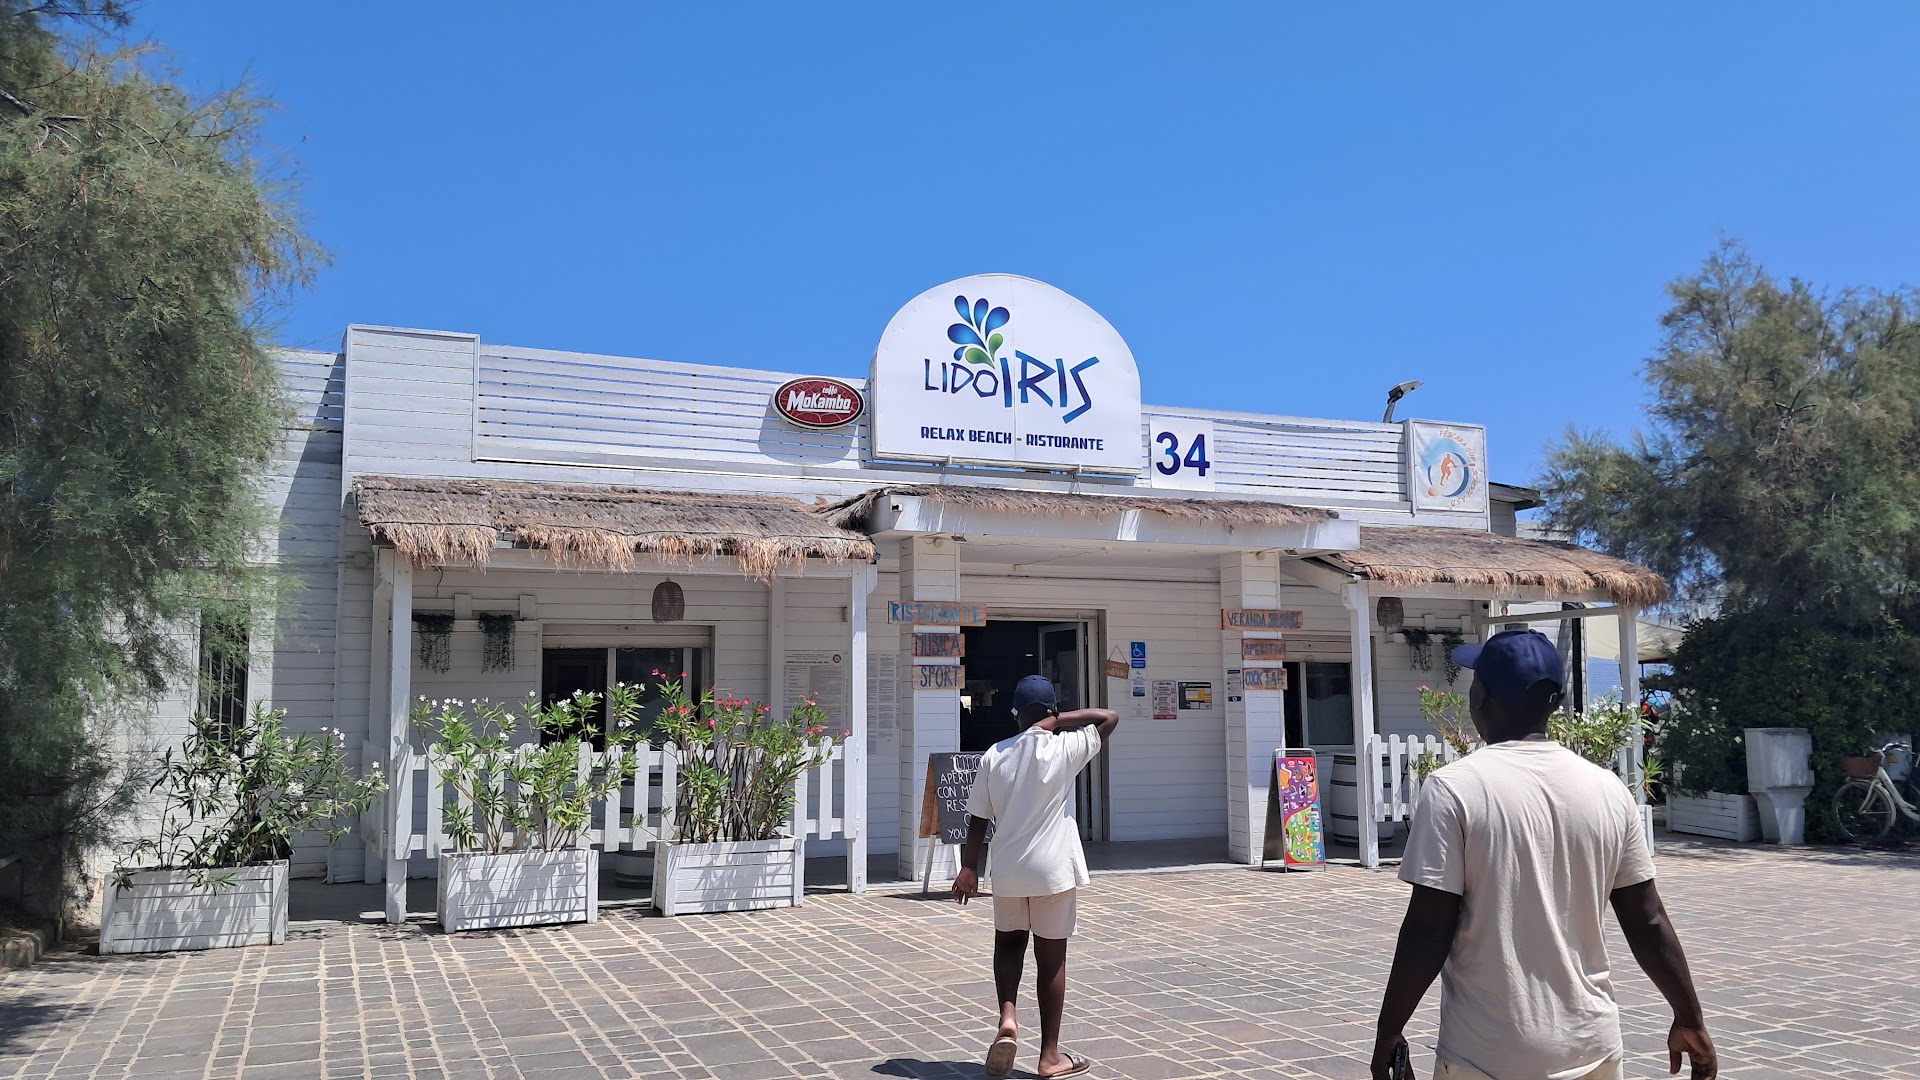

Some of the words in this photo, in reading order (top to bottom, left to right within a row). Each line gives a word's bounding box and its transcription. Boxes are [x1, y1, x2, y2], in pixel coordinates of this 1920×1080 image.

[924, 358, 999, 398] LIDO
[999, 349, 1100, 424] IRIS
[920, 426, 965, 441] RELAX
[968, 429, 1012, 445] BEACH
[1026, 433, 1104, 451] RISTORANTE
[1155, 431, 1211, 477] 34
[891, 602, 981, 625] RISTORANTE
[1227, 612, 1267, 627] VERANDA
[920, 665, 961, 688] SPORT
[937, 786, 957, 799] CON
[946, 799, 968, 812] RES
